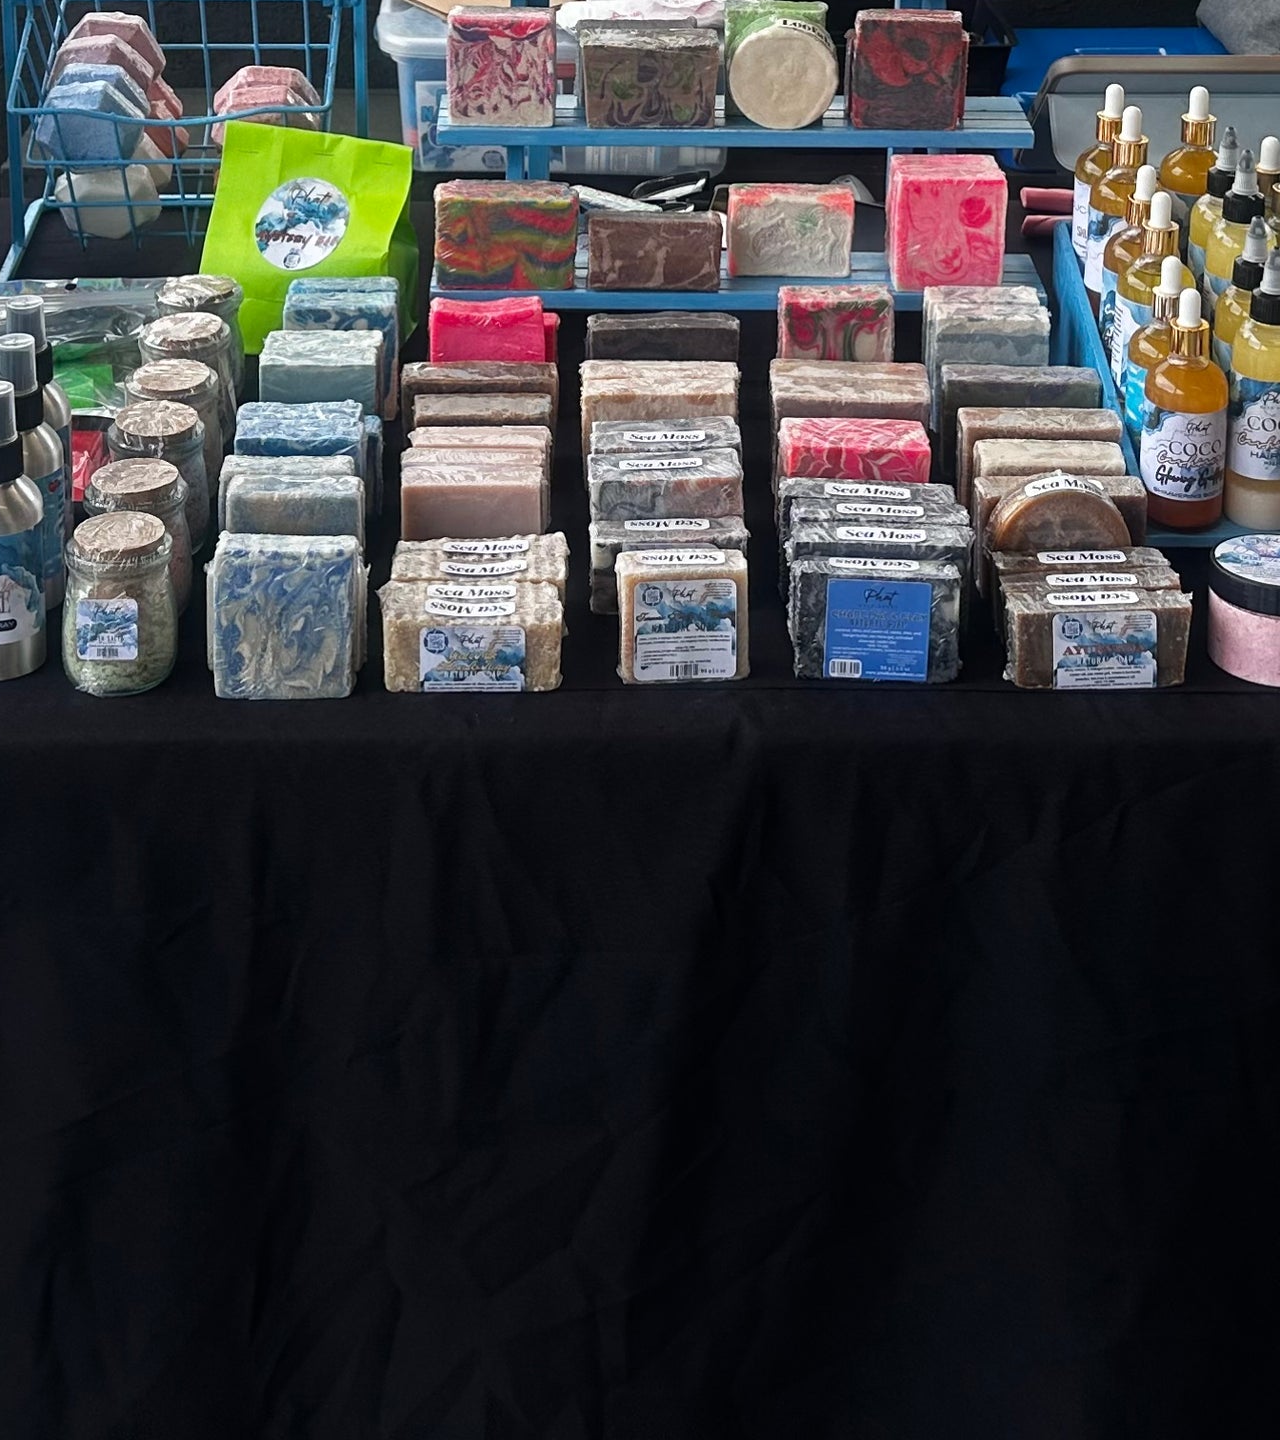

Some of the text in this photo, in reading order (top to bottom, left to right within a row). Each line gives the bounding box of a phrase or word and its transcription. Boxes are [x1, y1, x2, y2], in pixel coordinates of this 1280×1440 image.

[629, 433, 700, 441] Sea Moss
[1168, 439, 1222, 457] COCO
[656, 460, 697, 468] Moss
[1031, 479, 1060, 492] Sea
[832, 485, 906, 498] Sea Moss
[844, 505, 918, 515] Sea Moss
[629, 520, 671, 529] Moss
[846, 529, 922, 540] Sea Moss
[451, 543, 524, 552] Sea Moss
[641, 553, 719, 563] Sea Moss
[1046, 553, 1121, 561] Sea Moss
[447, 563, 521, 573] Sea Moss
[835, 559, 914, 569] Sea Moss
[1055, 574, 1132, 583] Sea Moss
[433, 587, 511, 597] Sea Moss
[1052, 593, 1096, 602] Moss
[430, 602, 472, 615] Moss
